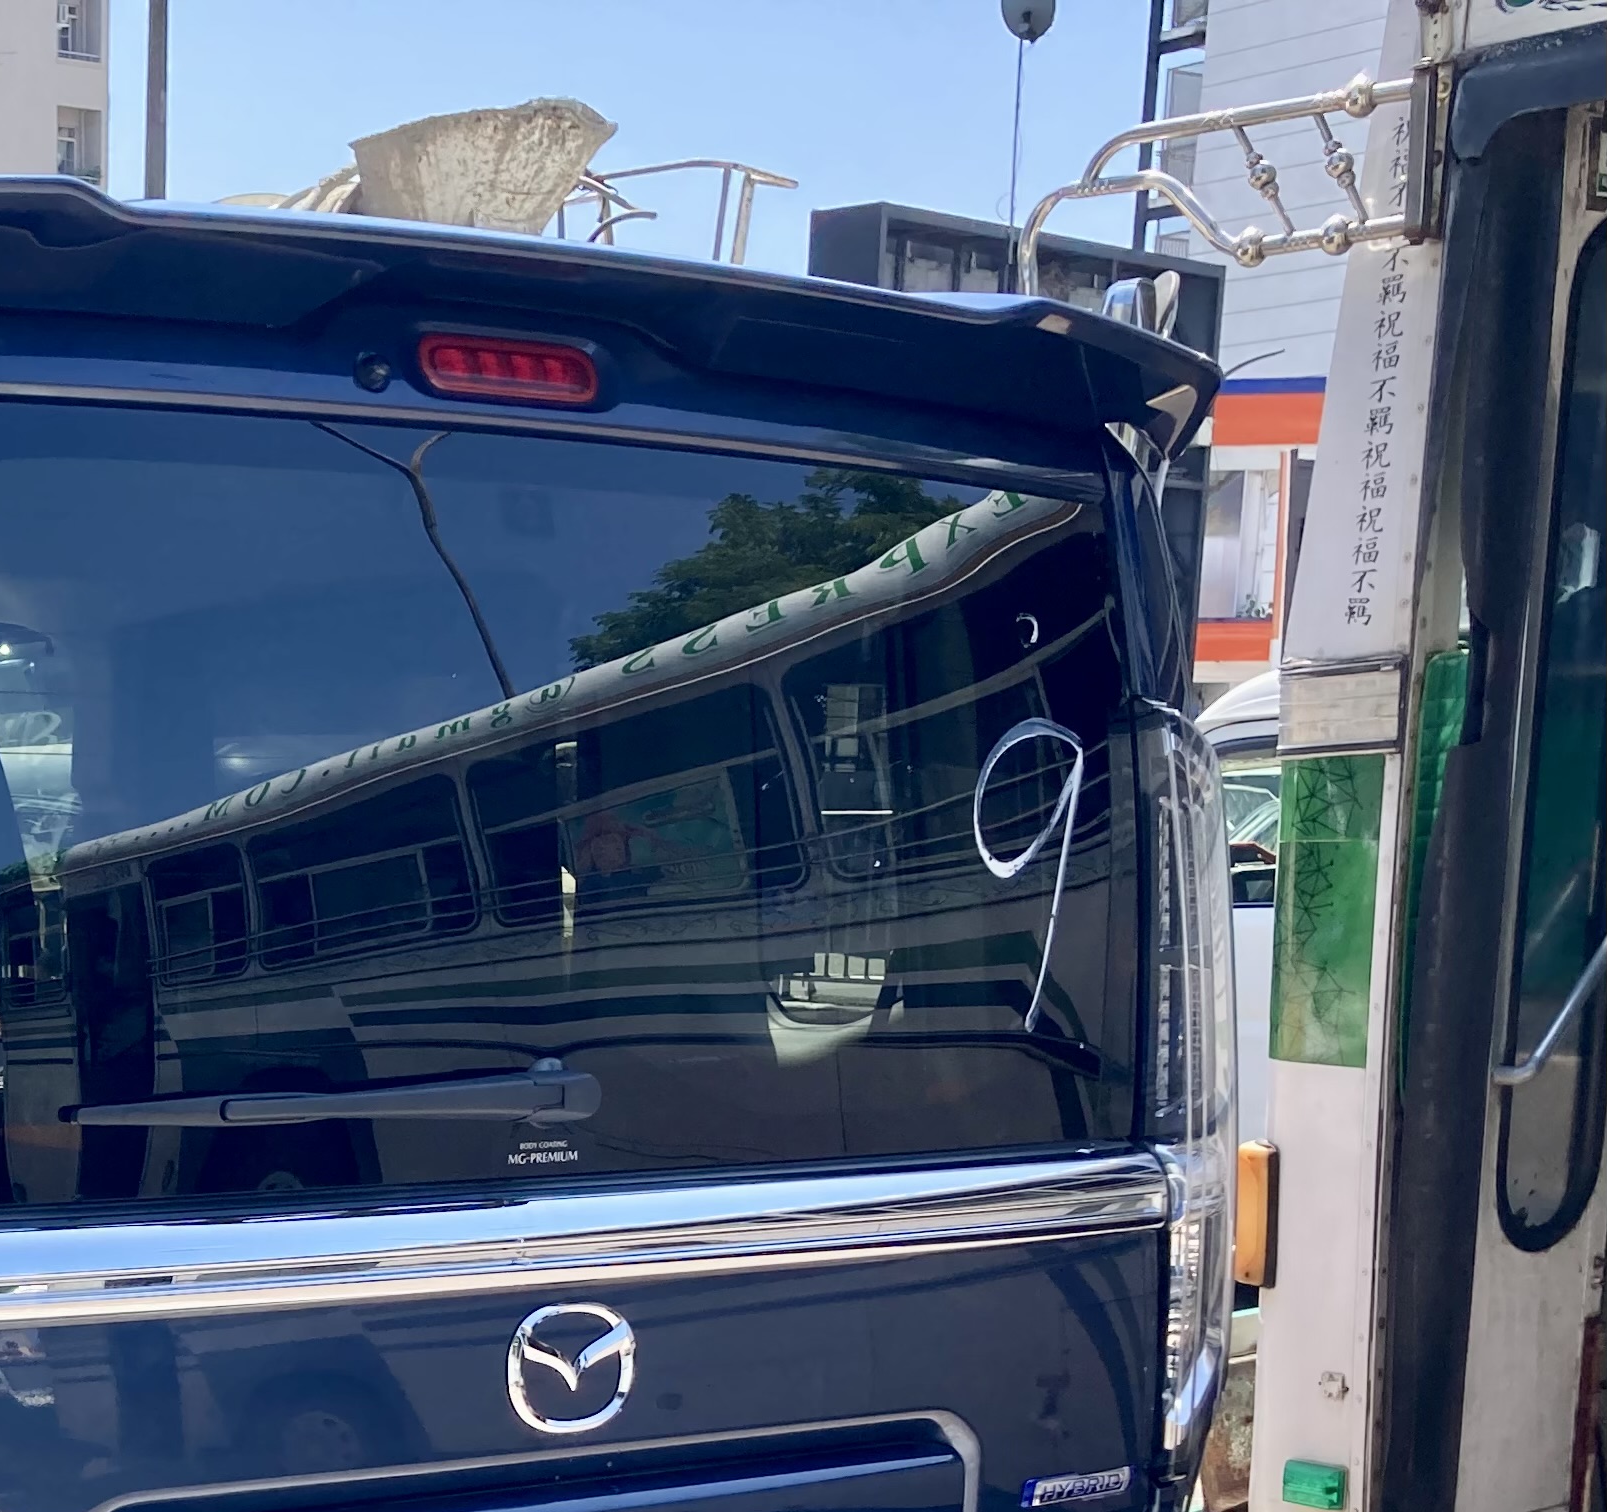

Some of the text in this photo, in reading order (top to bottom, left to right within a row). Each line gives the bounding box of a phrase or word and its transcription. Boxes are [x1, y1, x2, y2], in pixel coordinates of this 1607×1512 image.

[519, 1140, 567, 1150] BODY COATING
[507, 1150, 578, 1164] MG-PREMIUM
[1039, 1473, 1122, 1501] HYBRID
